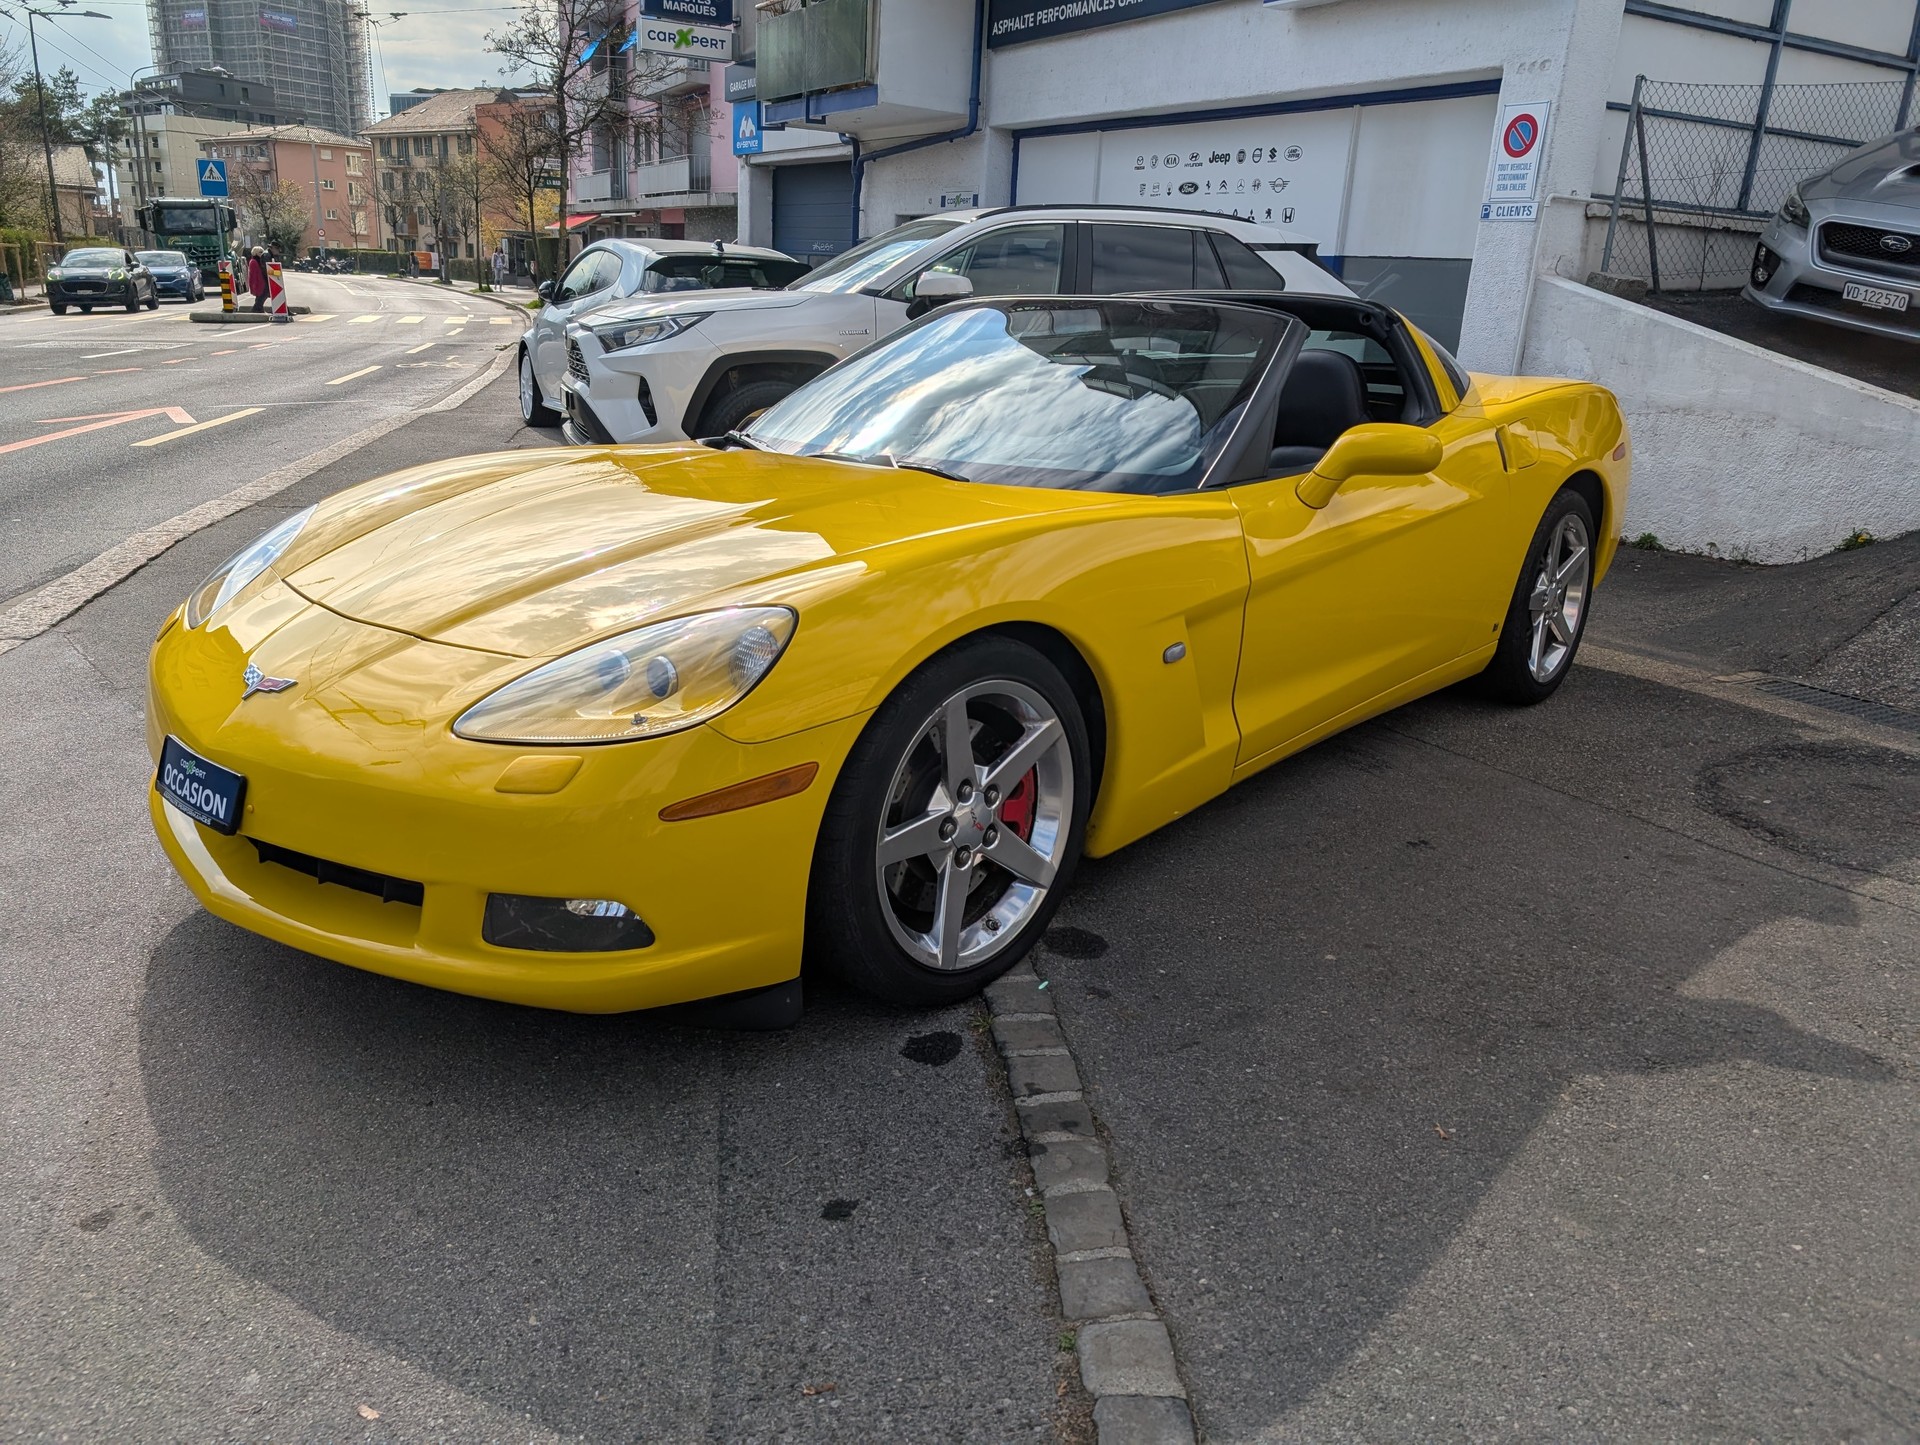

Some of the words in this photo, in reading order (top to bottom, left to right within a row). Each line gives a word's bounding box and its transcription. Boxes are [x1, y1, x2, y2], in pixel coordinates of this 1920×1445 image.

[663, 0, 717, 16] MARQUES
[992, 13, 1034, 35] ASPHALTE
[1036, 0, 1115, 26] PERFORMANCES
[729, 80, 747, 93] GARAGE
[1208, 151, 1231, 166] Jeep
[1497, 163, 1510, 171] TOUT
[1497, 172, 1529, 181] STATIONNANT
[1496, 183, 1508, 191] SERA
[1496, 205, 1533, 217] CLIENTS
[164, 763, 228, 820] OCCASION
